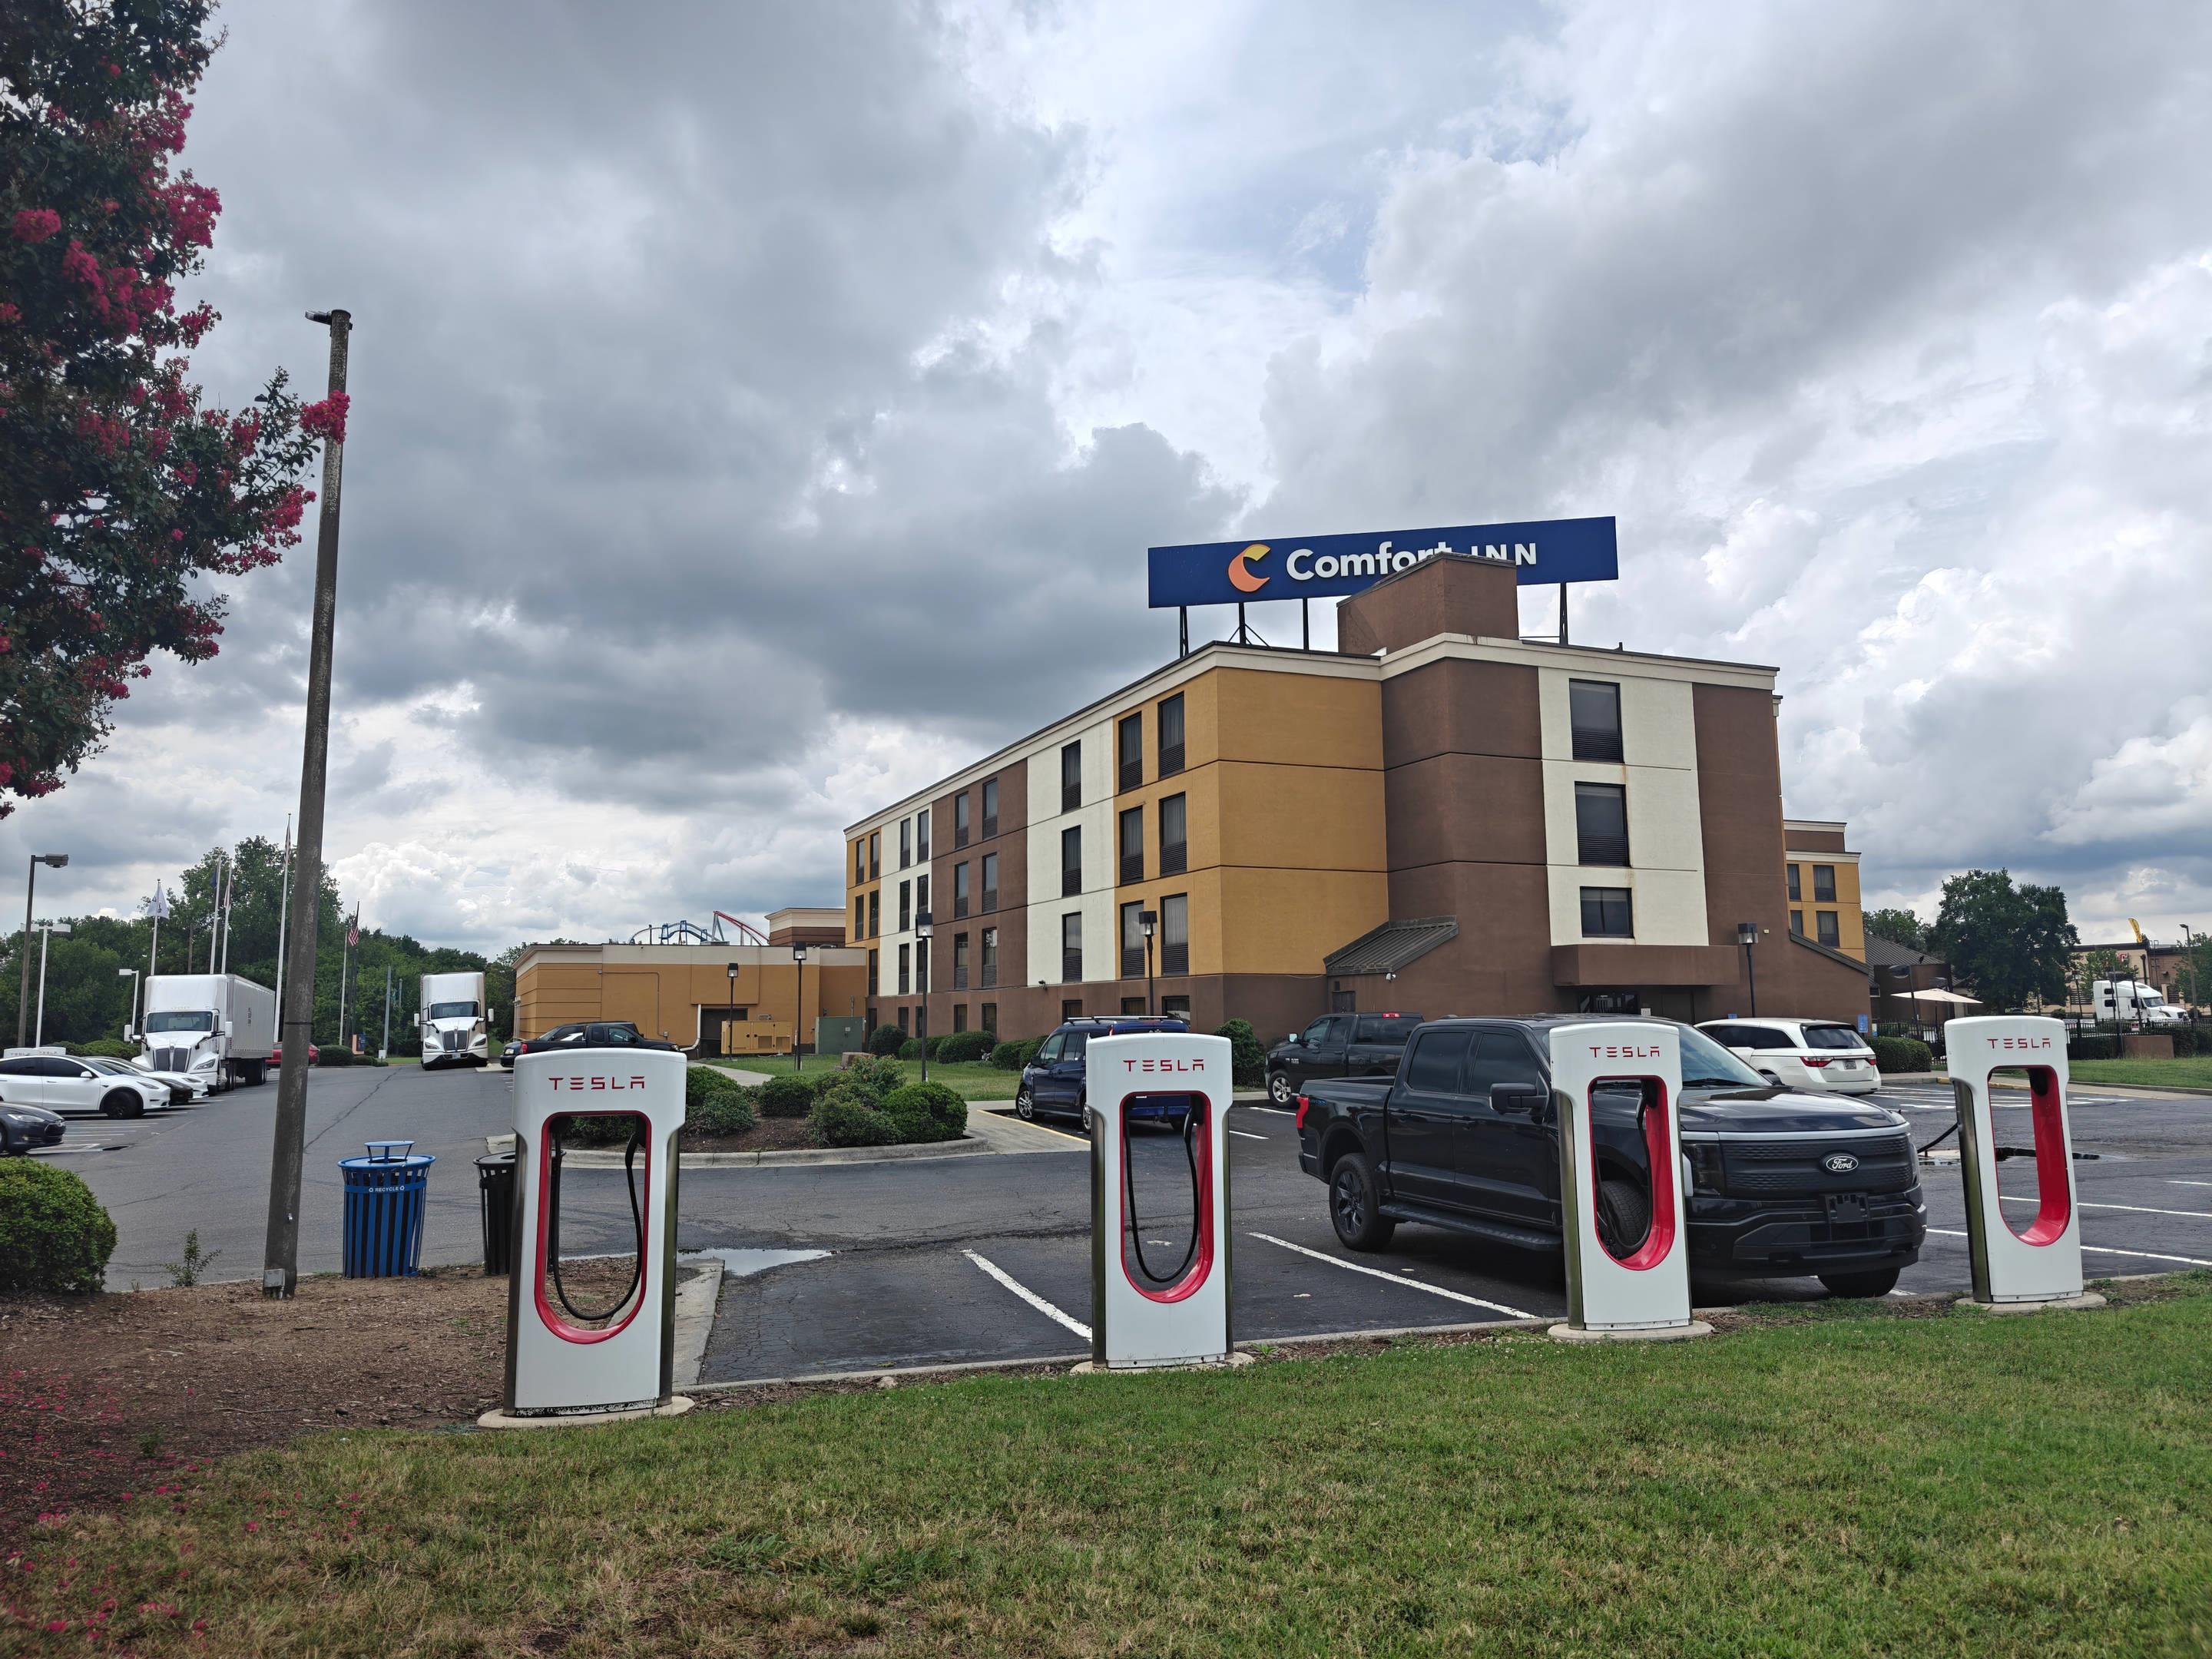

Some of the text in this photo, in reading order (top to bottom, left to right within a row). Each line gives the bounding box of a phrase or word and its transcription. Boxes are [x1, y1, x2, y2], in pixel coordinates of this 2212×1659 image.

[1986, 1038, 2051, 1049] TESLA
[1589, 1045, 1661, 1058] TESLA
[1122, 1058, 1204, 1073] TESLA
[548, 1075, 645, 1091] TESLA
[1832, 1157, 1853, 1169] Ford
